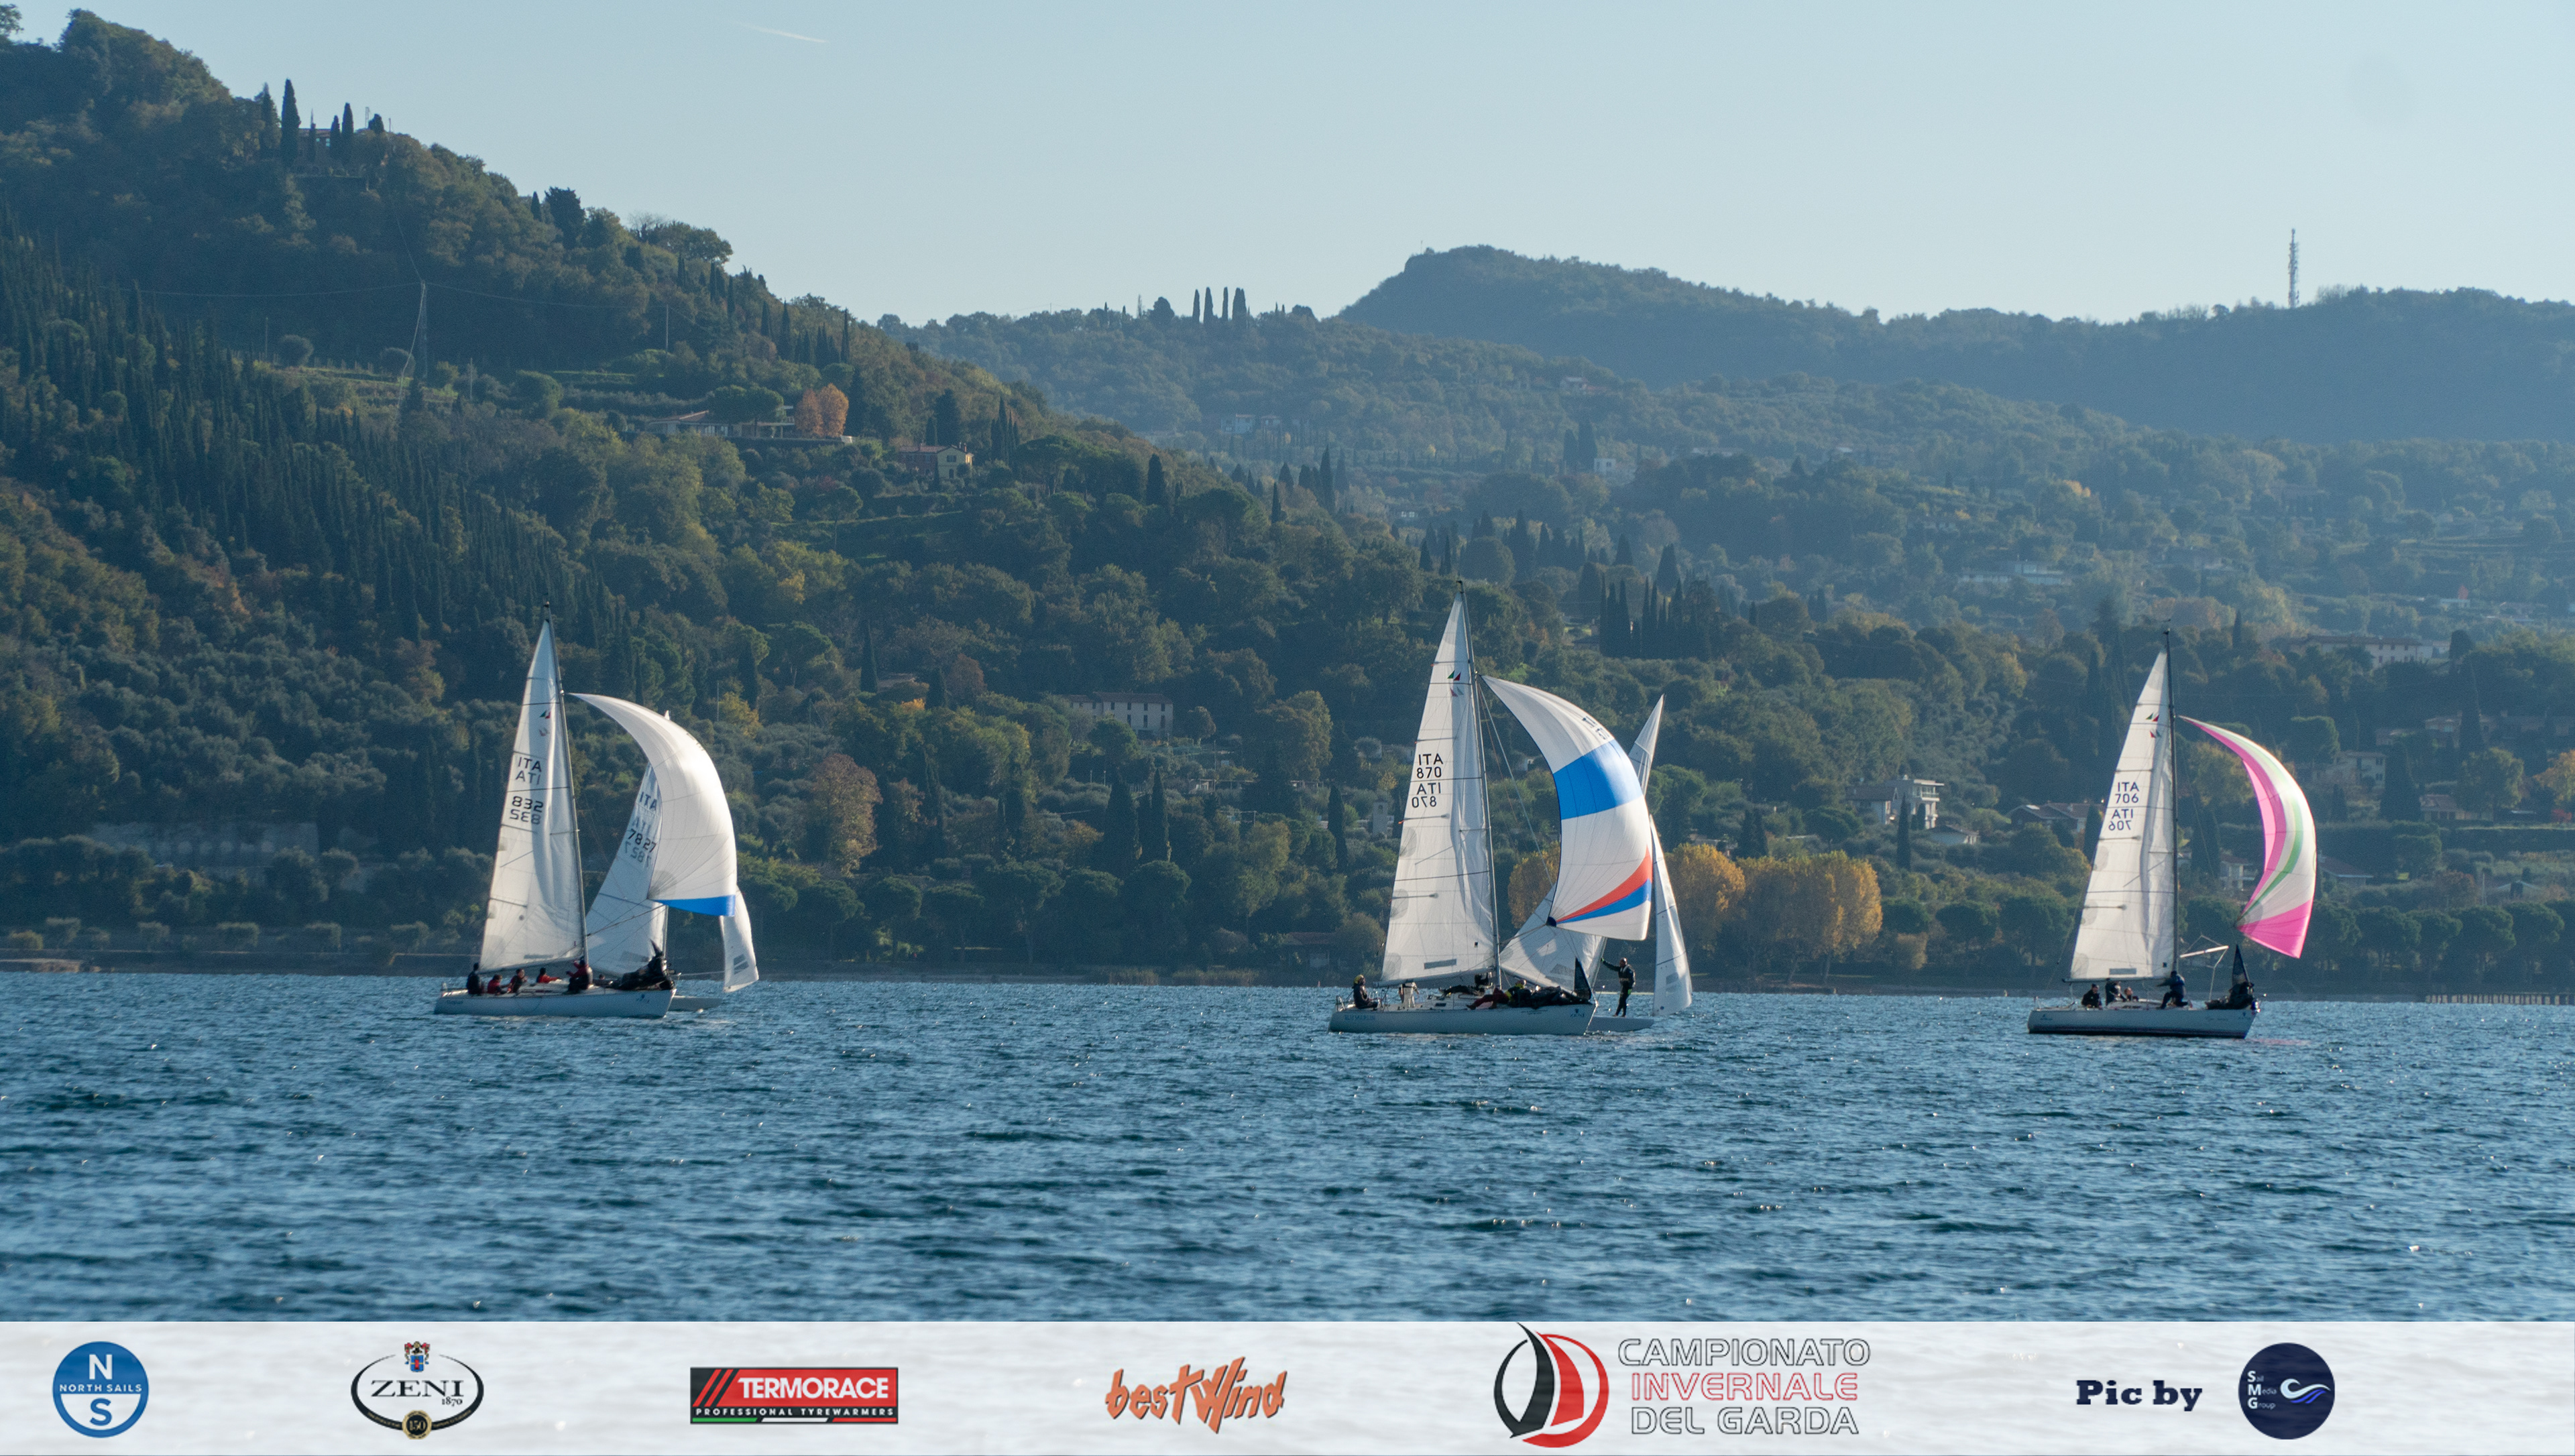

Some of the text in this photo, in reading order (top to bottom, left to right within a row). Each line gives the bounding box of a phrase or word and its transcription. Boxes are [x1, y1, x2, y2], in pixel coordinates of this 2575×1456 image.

[518, 757, 542, 772] ITA
[1418, 753, 1443, 766] ITA
[1416, 766, 1442, 779] 870
[2118, 782, 2139, 792] ITA
[512, 796, 544, 812] 832
[640, 792, 657, 811] ITA
[2115, 793, 2138, 804] 706
[628, 829, 656, 853] 7827
